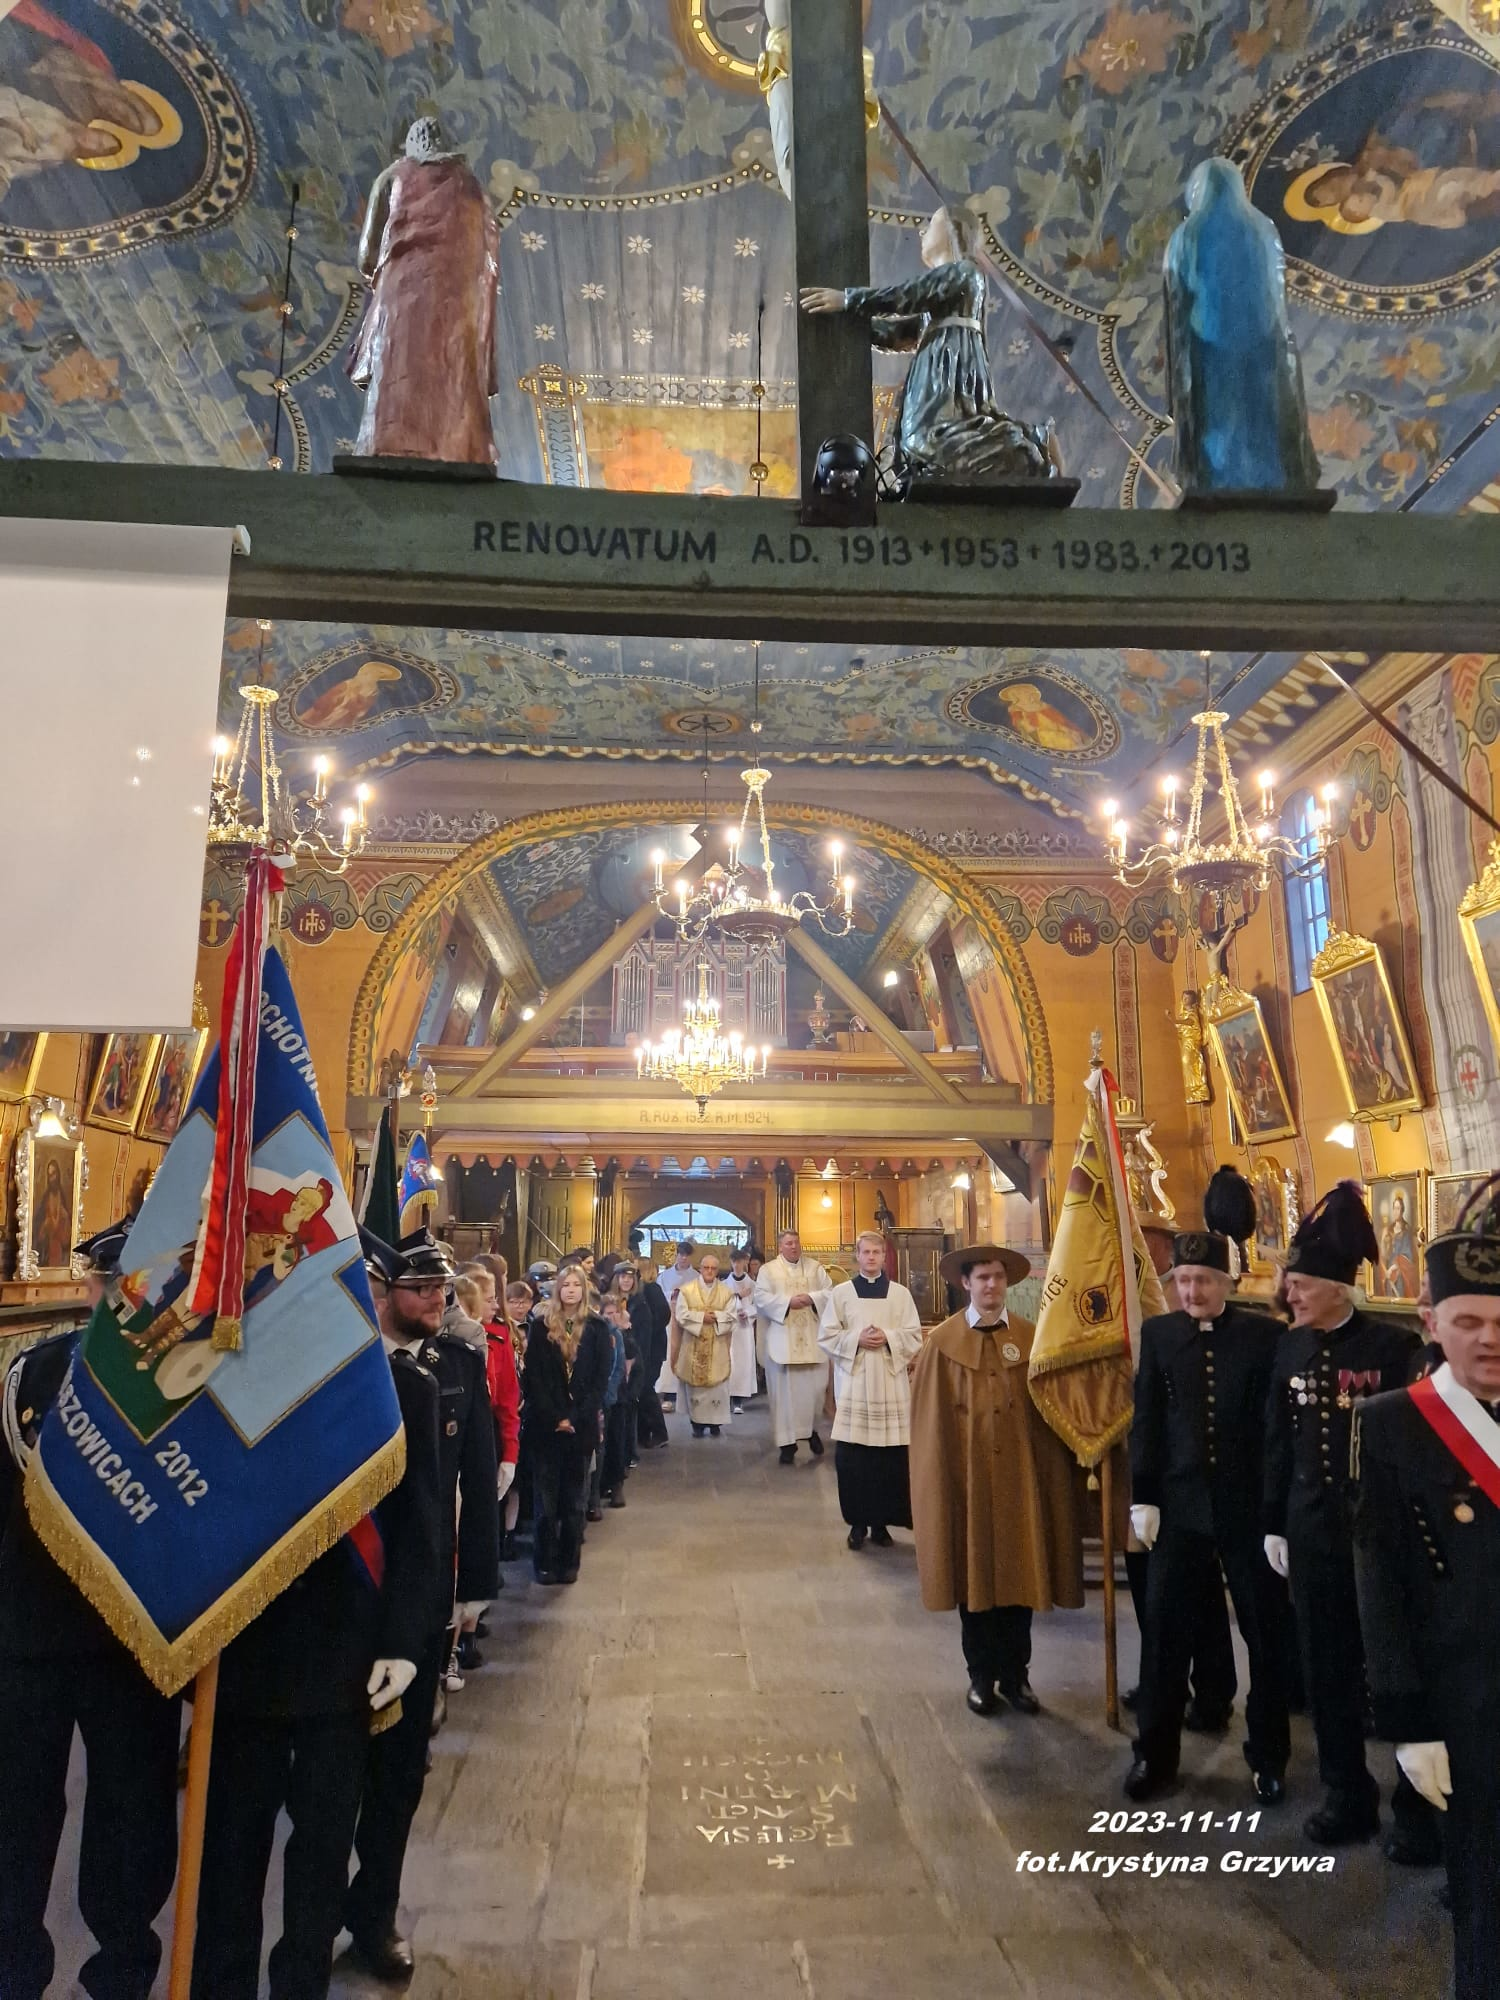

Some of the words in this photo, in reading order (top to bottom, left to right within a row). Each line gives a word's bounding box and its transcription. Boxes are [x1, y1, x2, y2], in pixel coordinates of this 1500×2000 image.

[473, 520, 716, 564] RENOVATUM
[751, 533, 819, 565] A.D.
[154, 1440, 209, 1508] 2012
